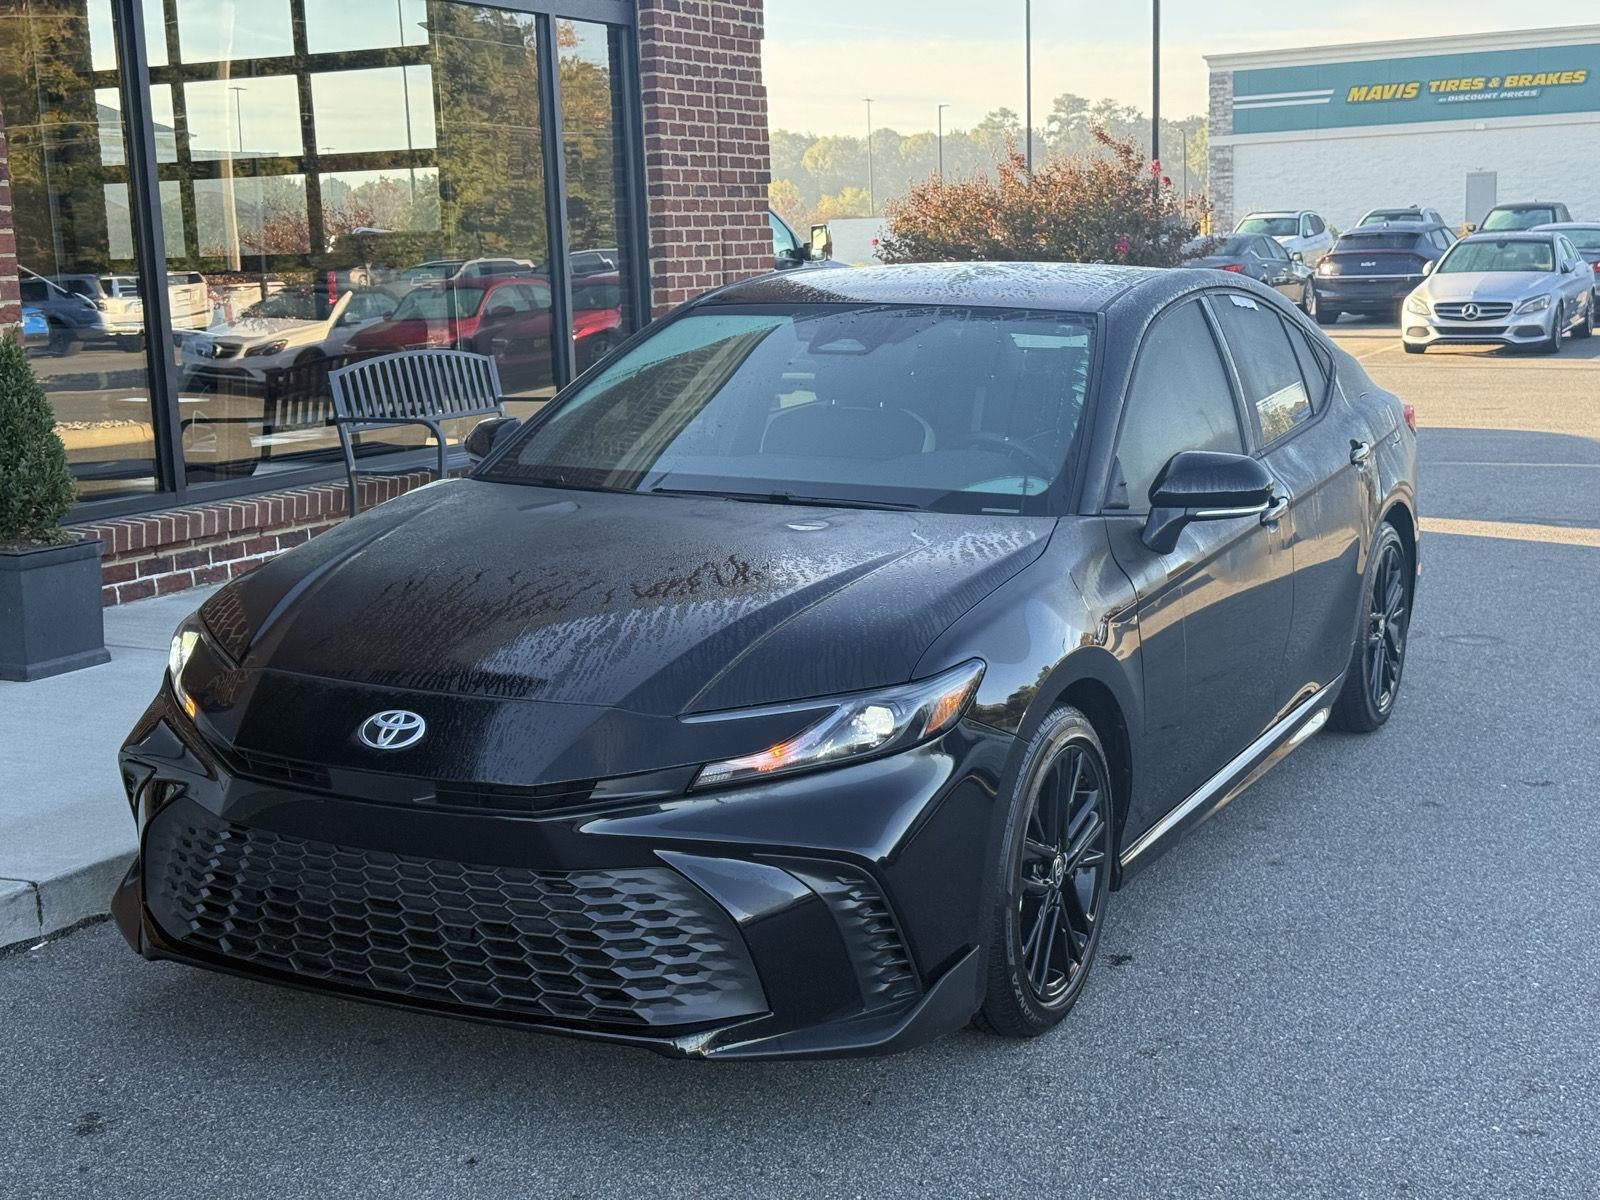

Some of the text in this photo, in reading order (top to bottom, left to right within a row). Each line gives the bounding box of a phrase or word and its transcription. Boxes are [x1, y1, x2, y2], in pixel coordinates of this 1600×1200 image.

[1347, 69, 1587, 103] MAVIS TIRES & BRAKES
[1447, 92, 1498, 102] DISCOUNT
[1500, 89, 1538, 98] PRICES
